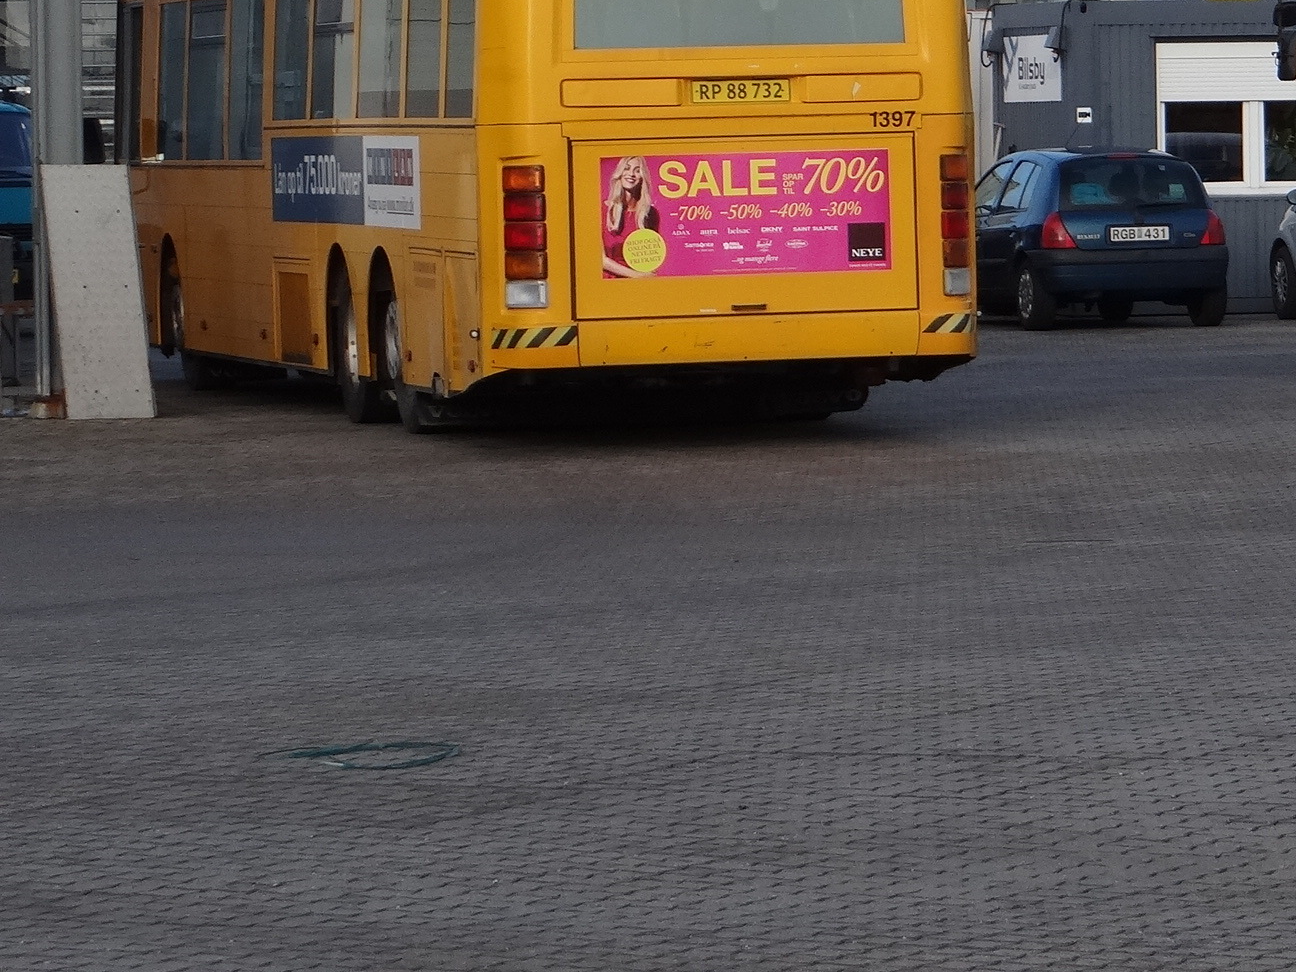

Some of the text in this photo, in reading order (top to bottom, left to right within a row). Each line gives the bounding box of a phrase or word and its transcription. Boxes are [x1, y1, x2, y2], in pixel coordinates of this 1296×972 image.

[1018, 57, 1045, 85] Bilsby
[700, 82, 782, 99] RP 88 732
[870, 111, 915, 127] 1397
[304, 154, 337, 195] 75.000
[658, 159, 777, 198] SALE
[782, 173, 803, 181] SPAR
[802, 157, 885, 195] 70%
[1112, 227, 1166, 240] RGB 431
[852, 248, 882, 257] NEYE
